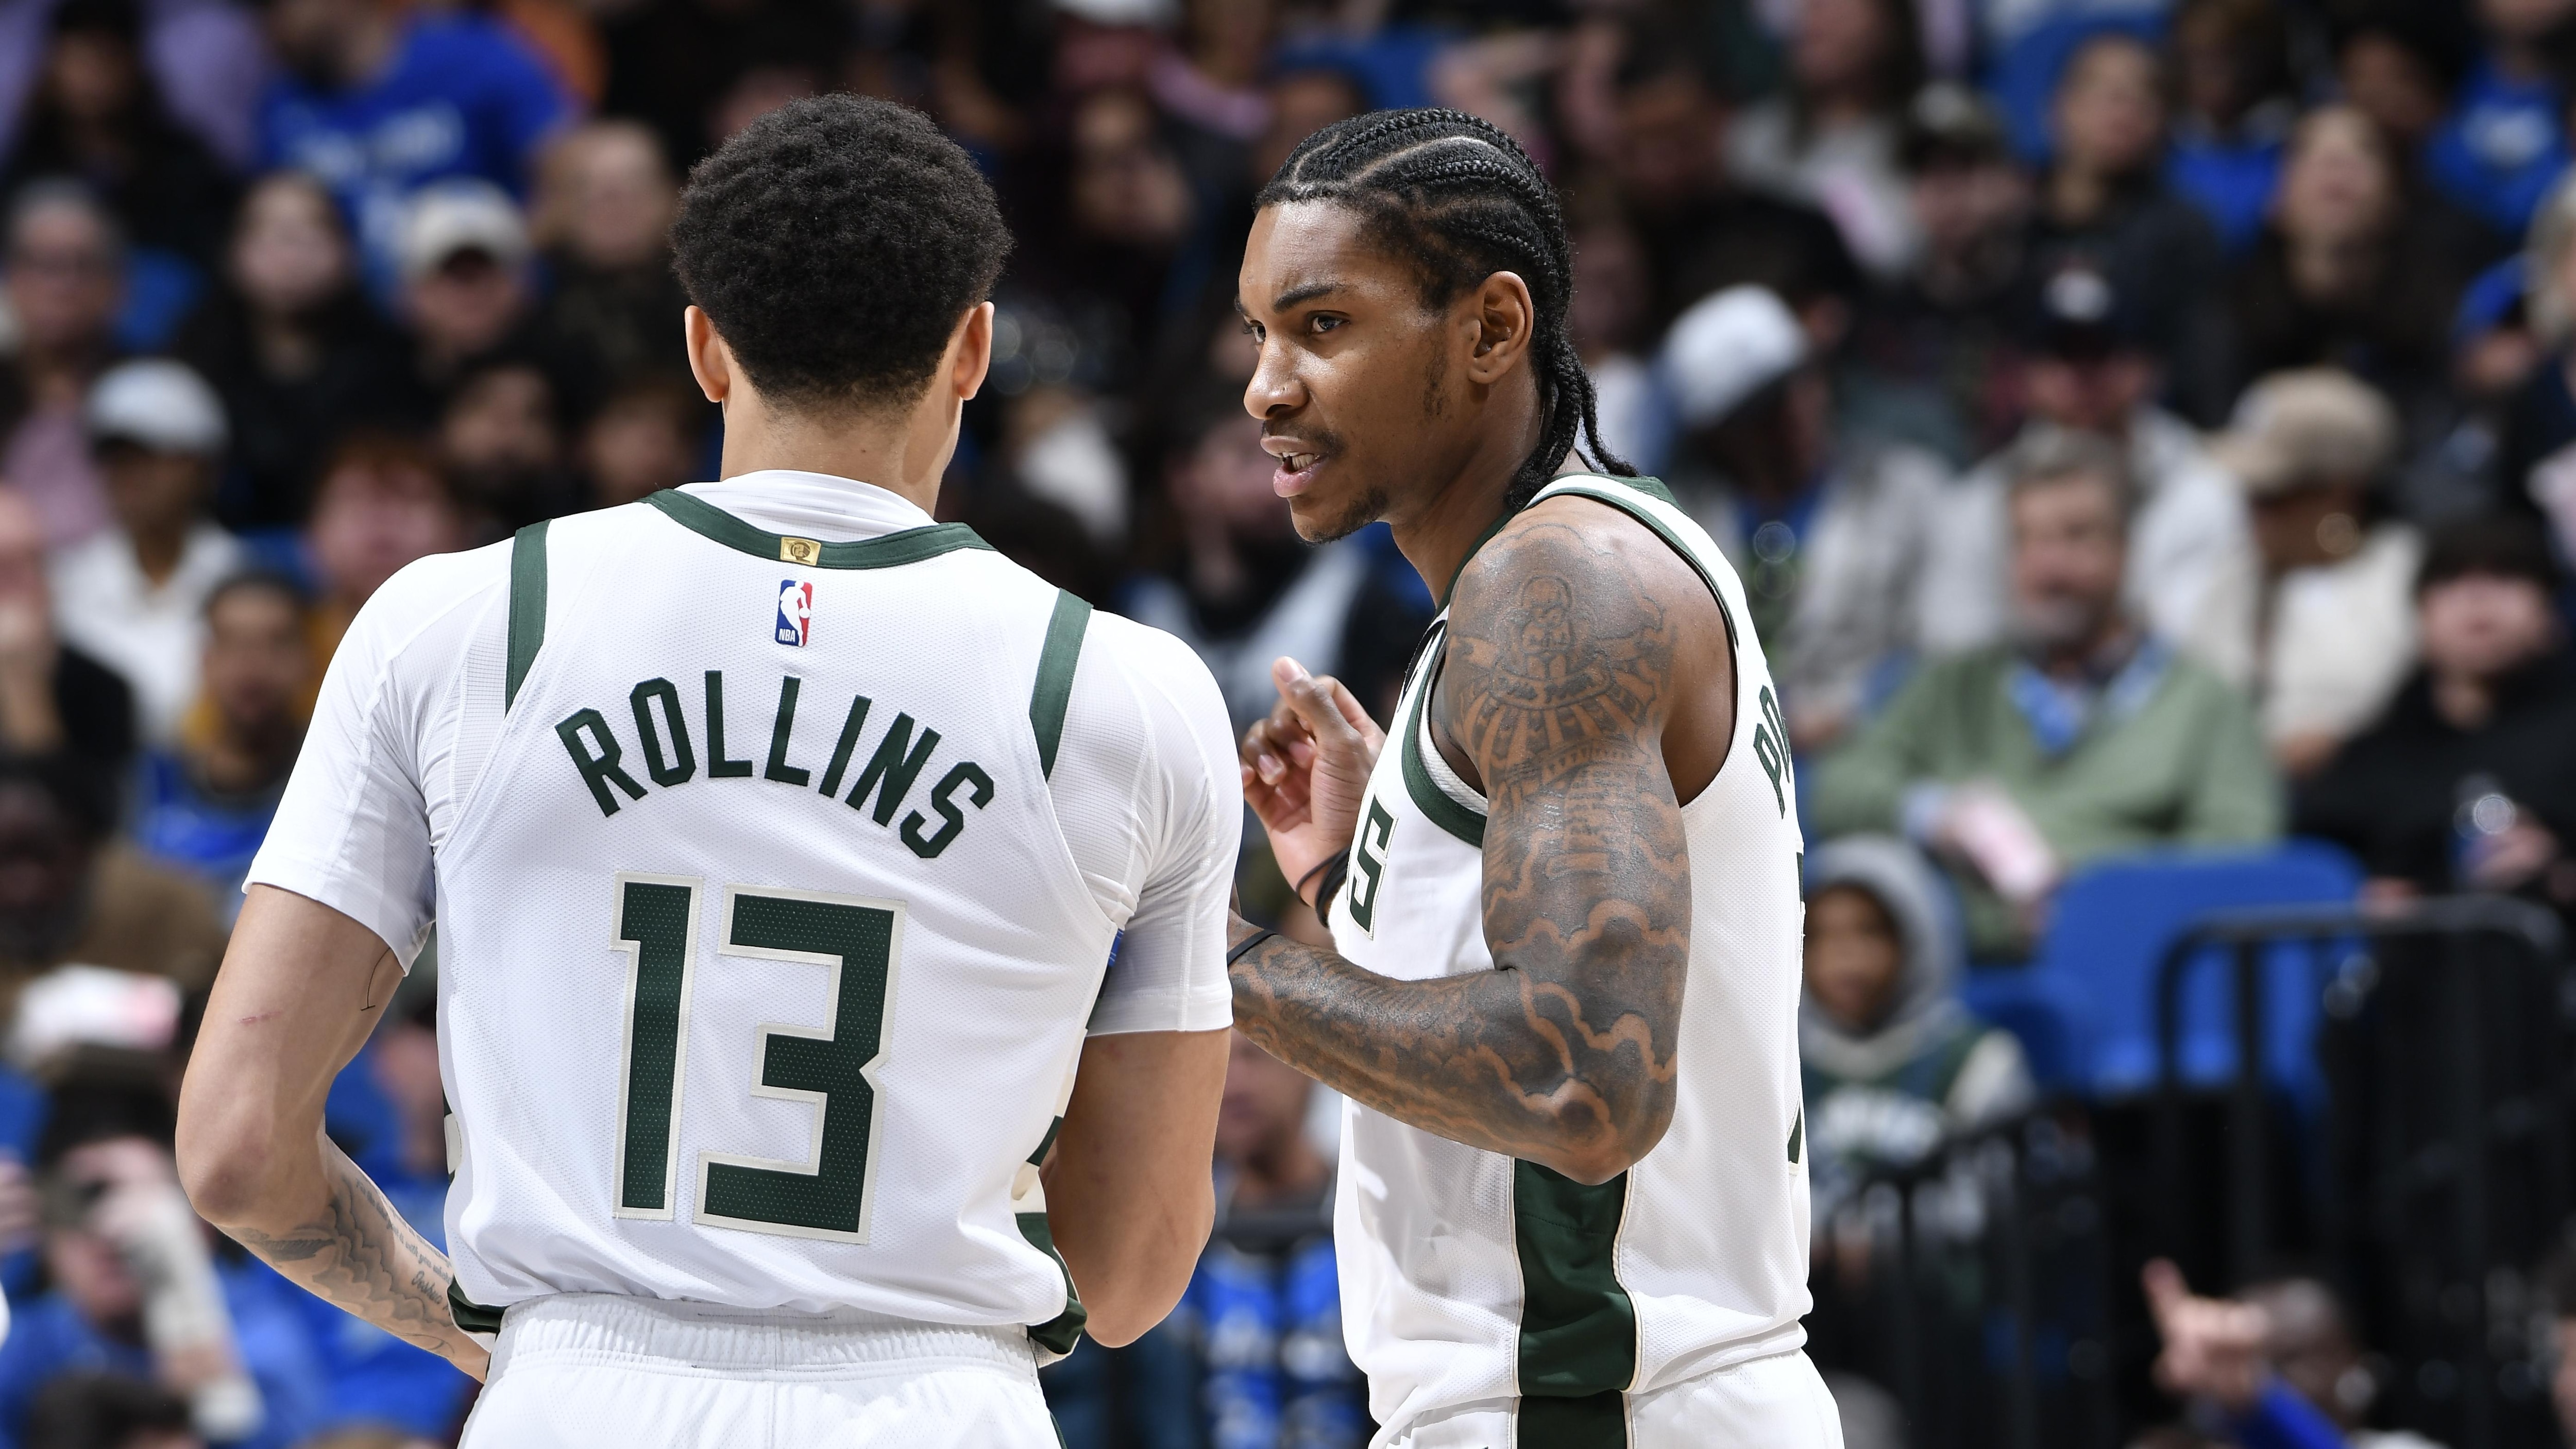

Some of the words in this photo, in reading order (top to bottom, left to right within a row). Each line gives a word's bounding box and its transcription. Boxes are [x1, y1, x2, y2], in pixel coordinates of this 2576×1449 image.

[778, 628, 795, 642] NBA
[554, 670, 994, 858] ROLLINS
[1753, 685, 1791, 820] PO
[608, 870, 907, 1244] 13
